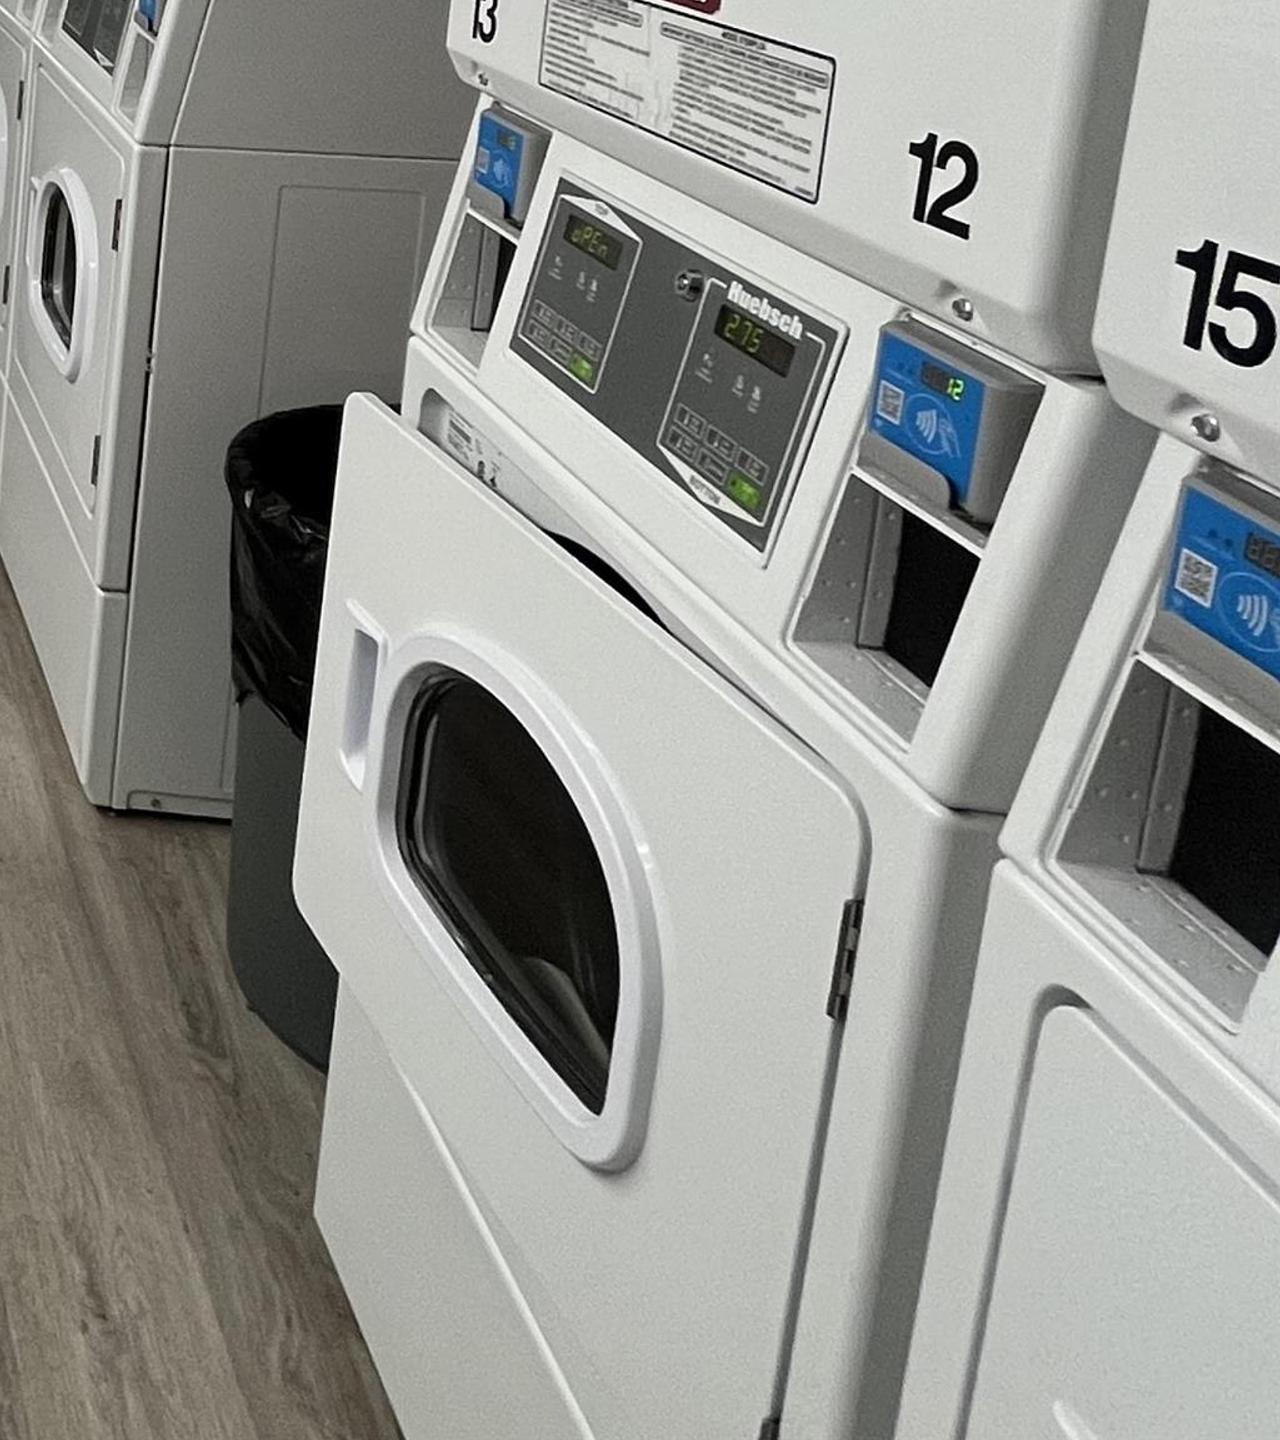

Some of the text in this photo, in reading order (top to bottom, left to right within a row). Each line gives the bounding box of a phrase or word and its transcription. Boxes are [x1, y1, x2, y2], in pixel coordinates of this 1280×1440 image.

[909, 132, 981, 240] 12
[727, 281, 803, 340] Huebsch
[1175, 239, 1280, 367] 15
[947, 378, 965, 401] 12
